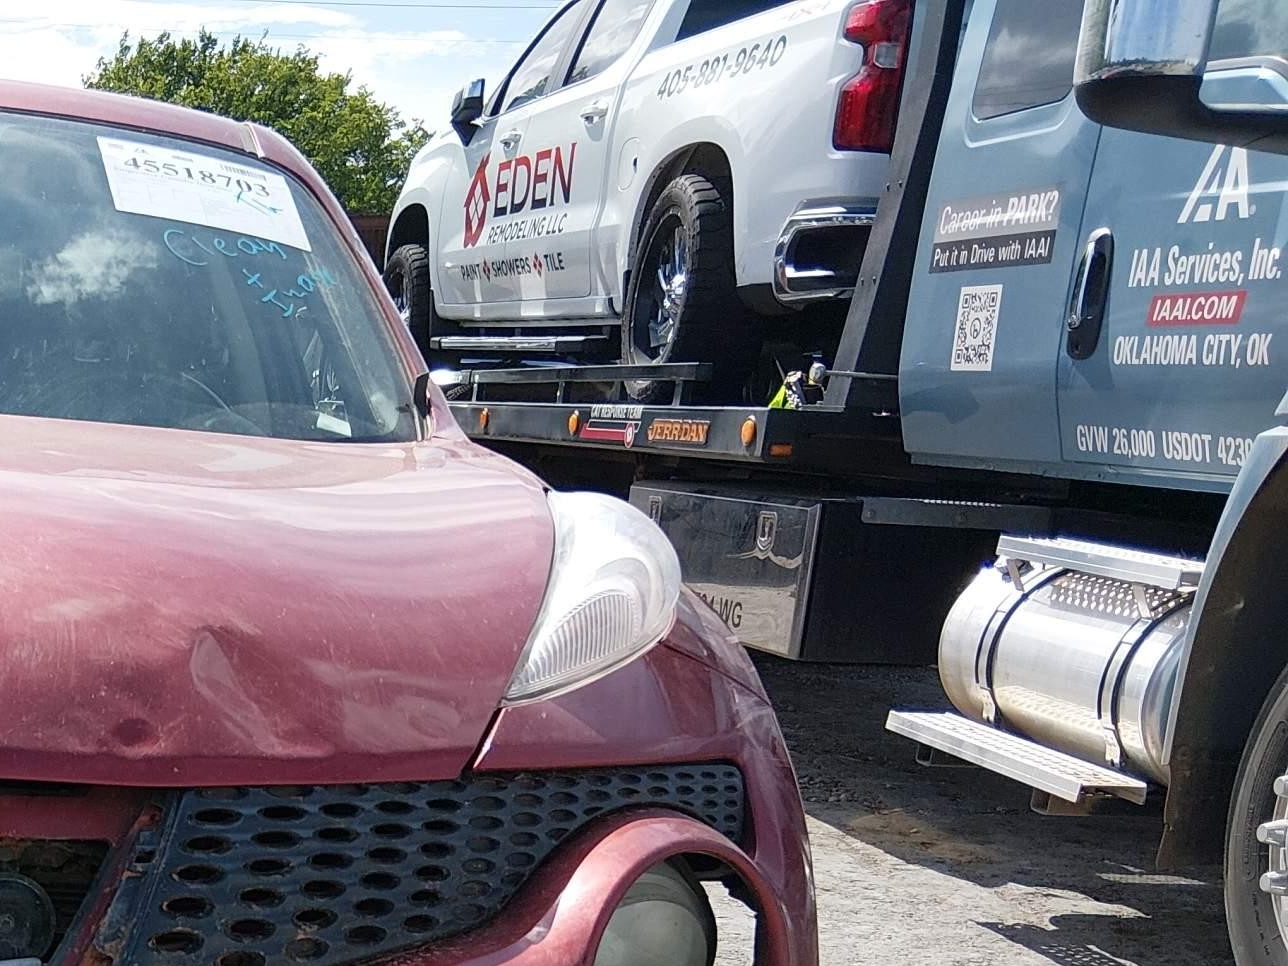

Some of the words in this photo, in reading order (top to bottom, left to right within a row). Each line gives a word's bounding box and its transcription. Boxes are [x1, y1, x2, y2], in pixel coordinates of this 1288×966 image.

[656, 35, 788, 100] 405-881-9640
[123, 157, 271, 198] 45518703
[493, 141, 578, 218] EDEN
[487, 217, 546, 245] REMODELING
[545, 213, 568, 236] LLC
[940, 205, 986, 234] Career
[986, 199, 1002, 229] in
[1002, 190, 1059, 226] PARK?
[163, 229, 288, 266] Clean
[933, 248, 950, 267] Put
[950, 245, 959, 266] it
[959, 244, 968, 265] in
[970, 242, 996, 264] Drive
[998, 240, 1021, 261] with
[1024, 236, 1051, 259] IAAI
[1128, 247, 1162, 288] IAA
[1164, 242, 1245, 286] Services,
[1248, 238, 1282, 281] Inc.
[460, 263, 482, 282] PAINT
[491, 257, 531, 278] SHOWERS
[543, 252, 565, 272] TILE
[1152, 295, 1239, 322] IAAI.COM
[1113, 334, 1197, 366] OKLAHOMA
[1202, 333, 1243, 369] CITY,
[1246, 333, 1273, 366] OK
[1076, 425, 1108, 454] GVW
[1112, 427, 1156, 459] 26,000
[1162, 431, 1212, 463] USDOT
